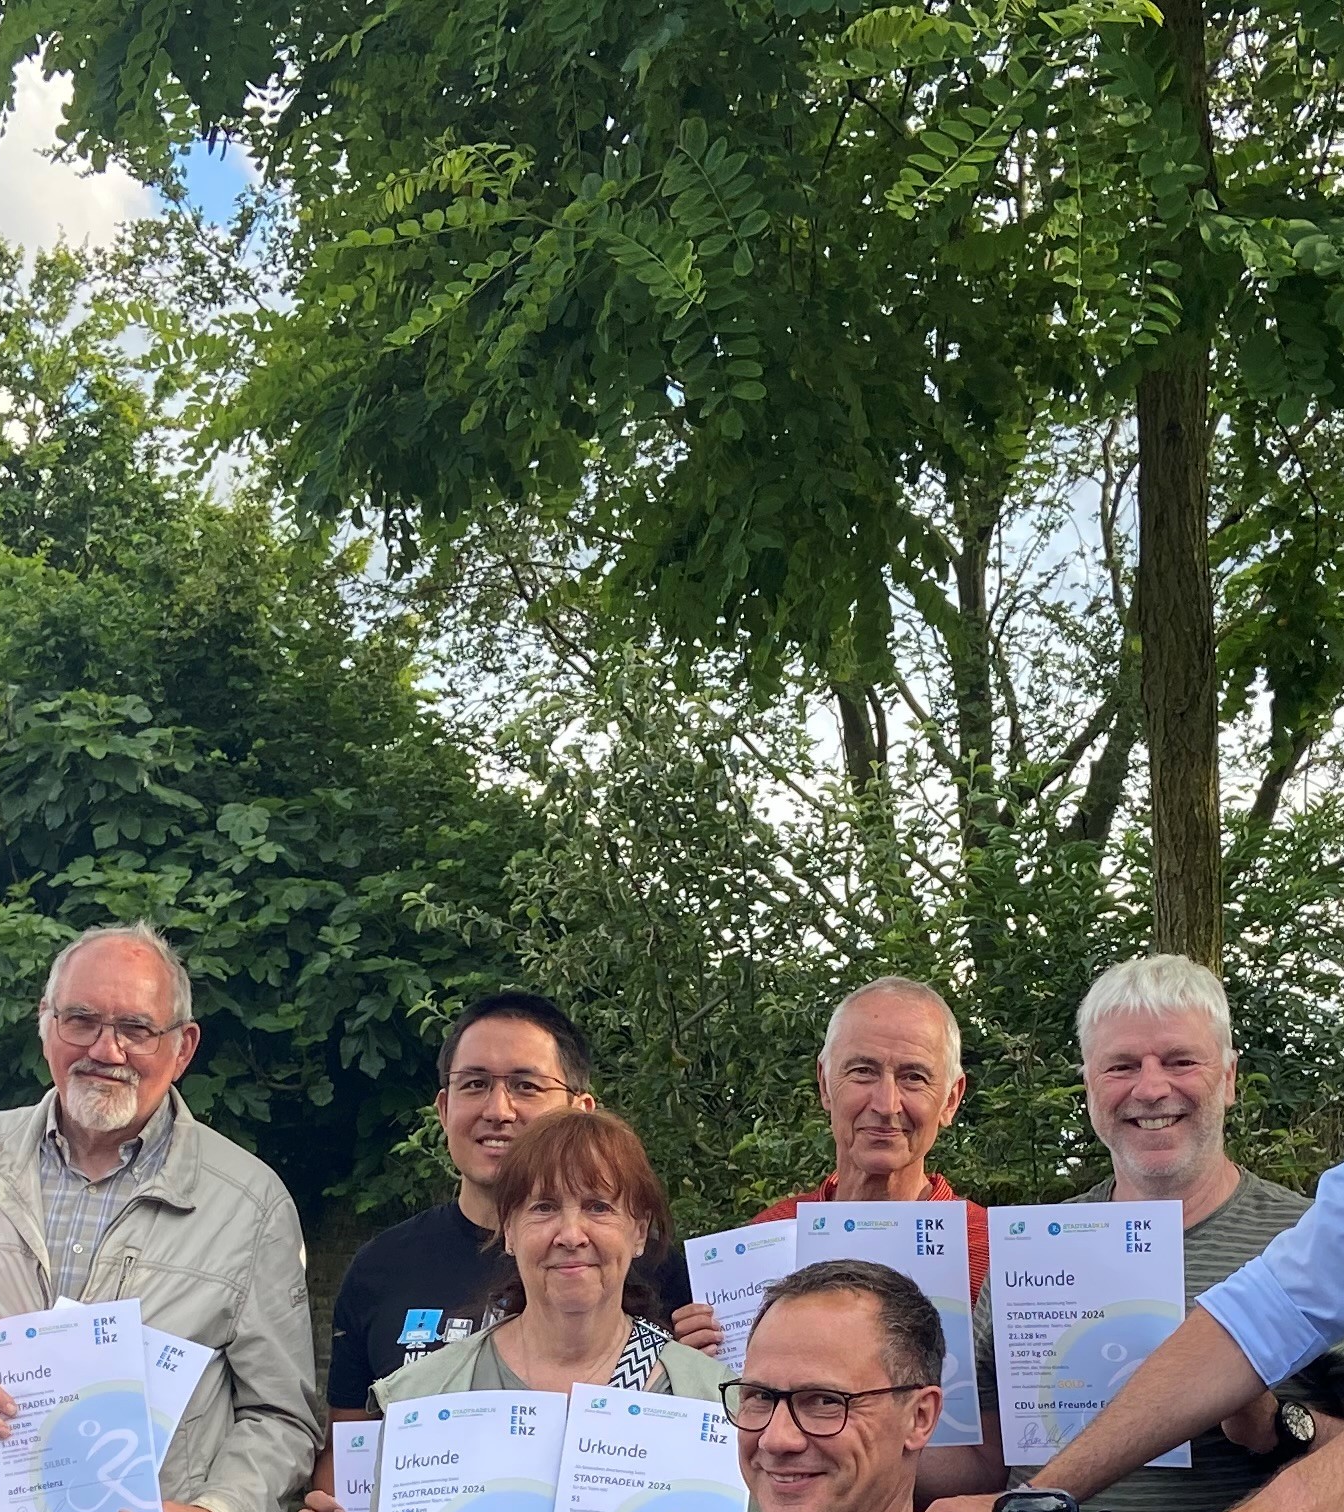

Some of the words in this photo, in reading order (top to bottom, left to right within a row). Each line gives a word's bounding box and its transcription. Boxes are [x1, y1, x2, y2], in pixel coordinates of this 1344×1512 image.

[915, 1218, 945, 1231] ERK
[1125, 1219, 1152, 1231] ERK
[916, 1231, 933, 1243] EL
[1125, 1231, 1141, 1242] EL
[916, 1244, 945, 1256] ENZ
[1126, 1242, 1152, 1253] ENZ
[1004, 1269, 1075, 1288] Urkunde
[704, 1281, 763, 1306] Urkunde
[93, 1315, 118, 1327] ERK
[1006, 1310, 1078, 1321] STADTRADELN
[1081, 1309, 1105, 1319] 2024
[94, 1325, 108, 1336] EL
[719, 1317, 754, 1333] ADTRAD
[96, 1333, 118, 1346] ENZ
[1035, 1332, 1048, 1340] km
[1010, 1349, 1030, 1358] 3.507
[1032, 1350, 1042, 1359] kg
[17, 1397, 56, 1412] TRADELN
[58, 1393, 80, 1404] 2024
[1013, 1401, 1035, 1411] CDU
[1038, 1400, 1056, 1410] und
[1058, 1399, 1098, 1410] Freunde
[511, 1405, 537, 1416] ERK
[510, 1415, 526, 1425] EL
[702, 1412, 730, 1427] ERK
[510, 1425, 536, 1436] ENZ
[701, 1422, 717, 1434] EL
[699, 1431, 729, 1445] ENZ
[577, 1437, 648, 1460] Urkunde
[44, 1457, 72, 1471] SILBER
[394, 1450, 460, 1471] Urkunde
[346, 1479, 375, 1496] Urk
[573, 1472, 645, 1489] STADTRADELN
[647, 1480, 671, 1492] 2024
[392, 1485, 459, 1502] STADTRADELN
[461, 1484, 486, 1495] 2024
